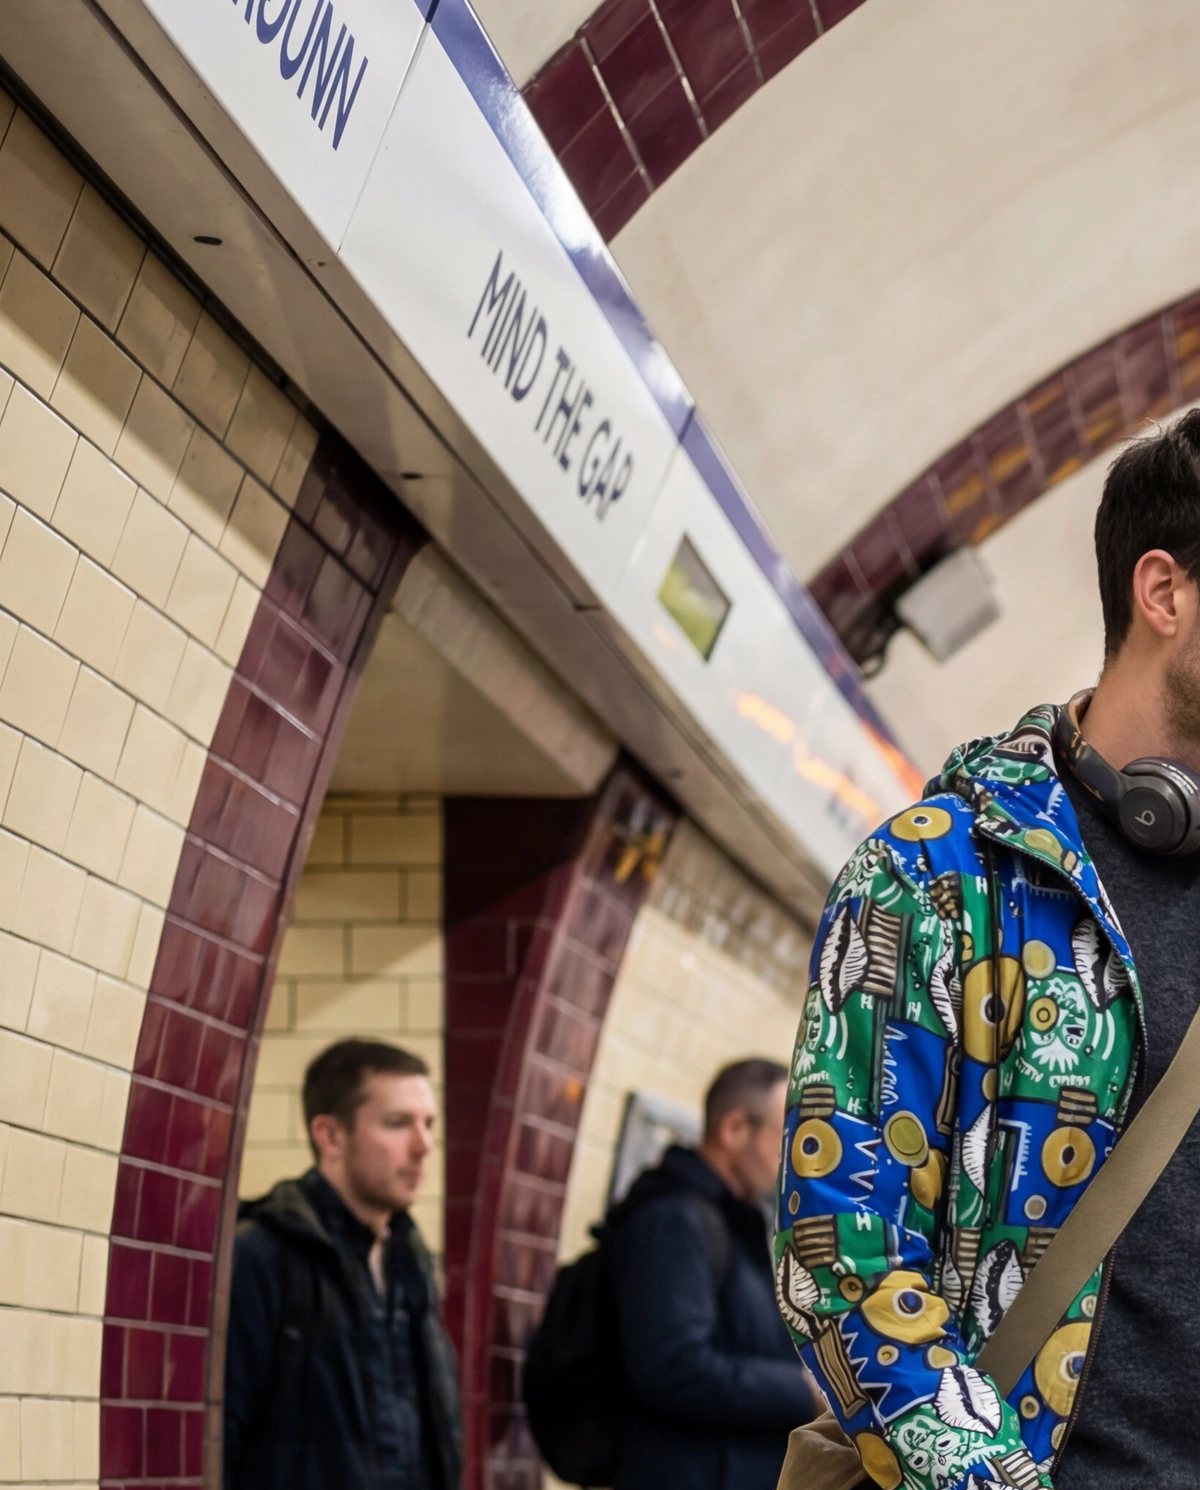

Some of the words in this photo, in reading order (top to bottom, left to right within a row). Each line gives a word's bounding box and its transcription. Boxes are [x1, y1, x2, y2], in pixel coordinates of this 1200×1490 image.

[232, 0, 369, 151] UNN
[467, 249, 547, 403] MIND
[534, 346, 594, 472] THE
[578, 417, 634, 524] GAP
